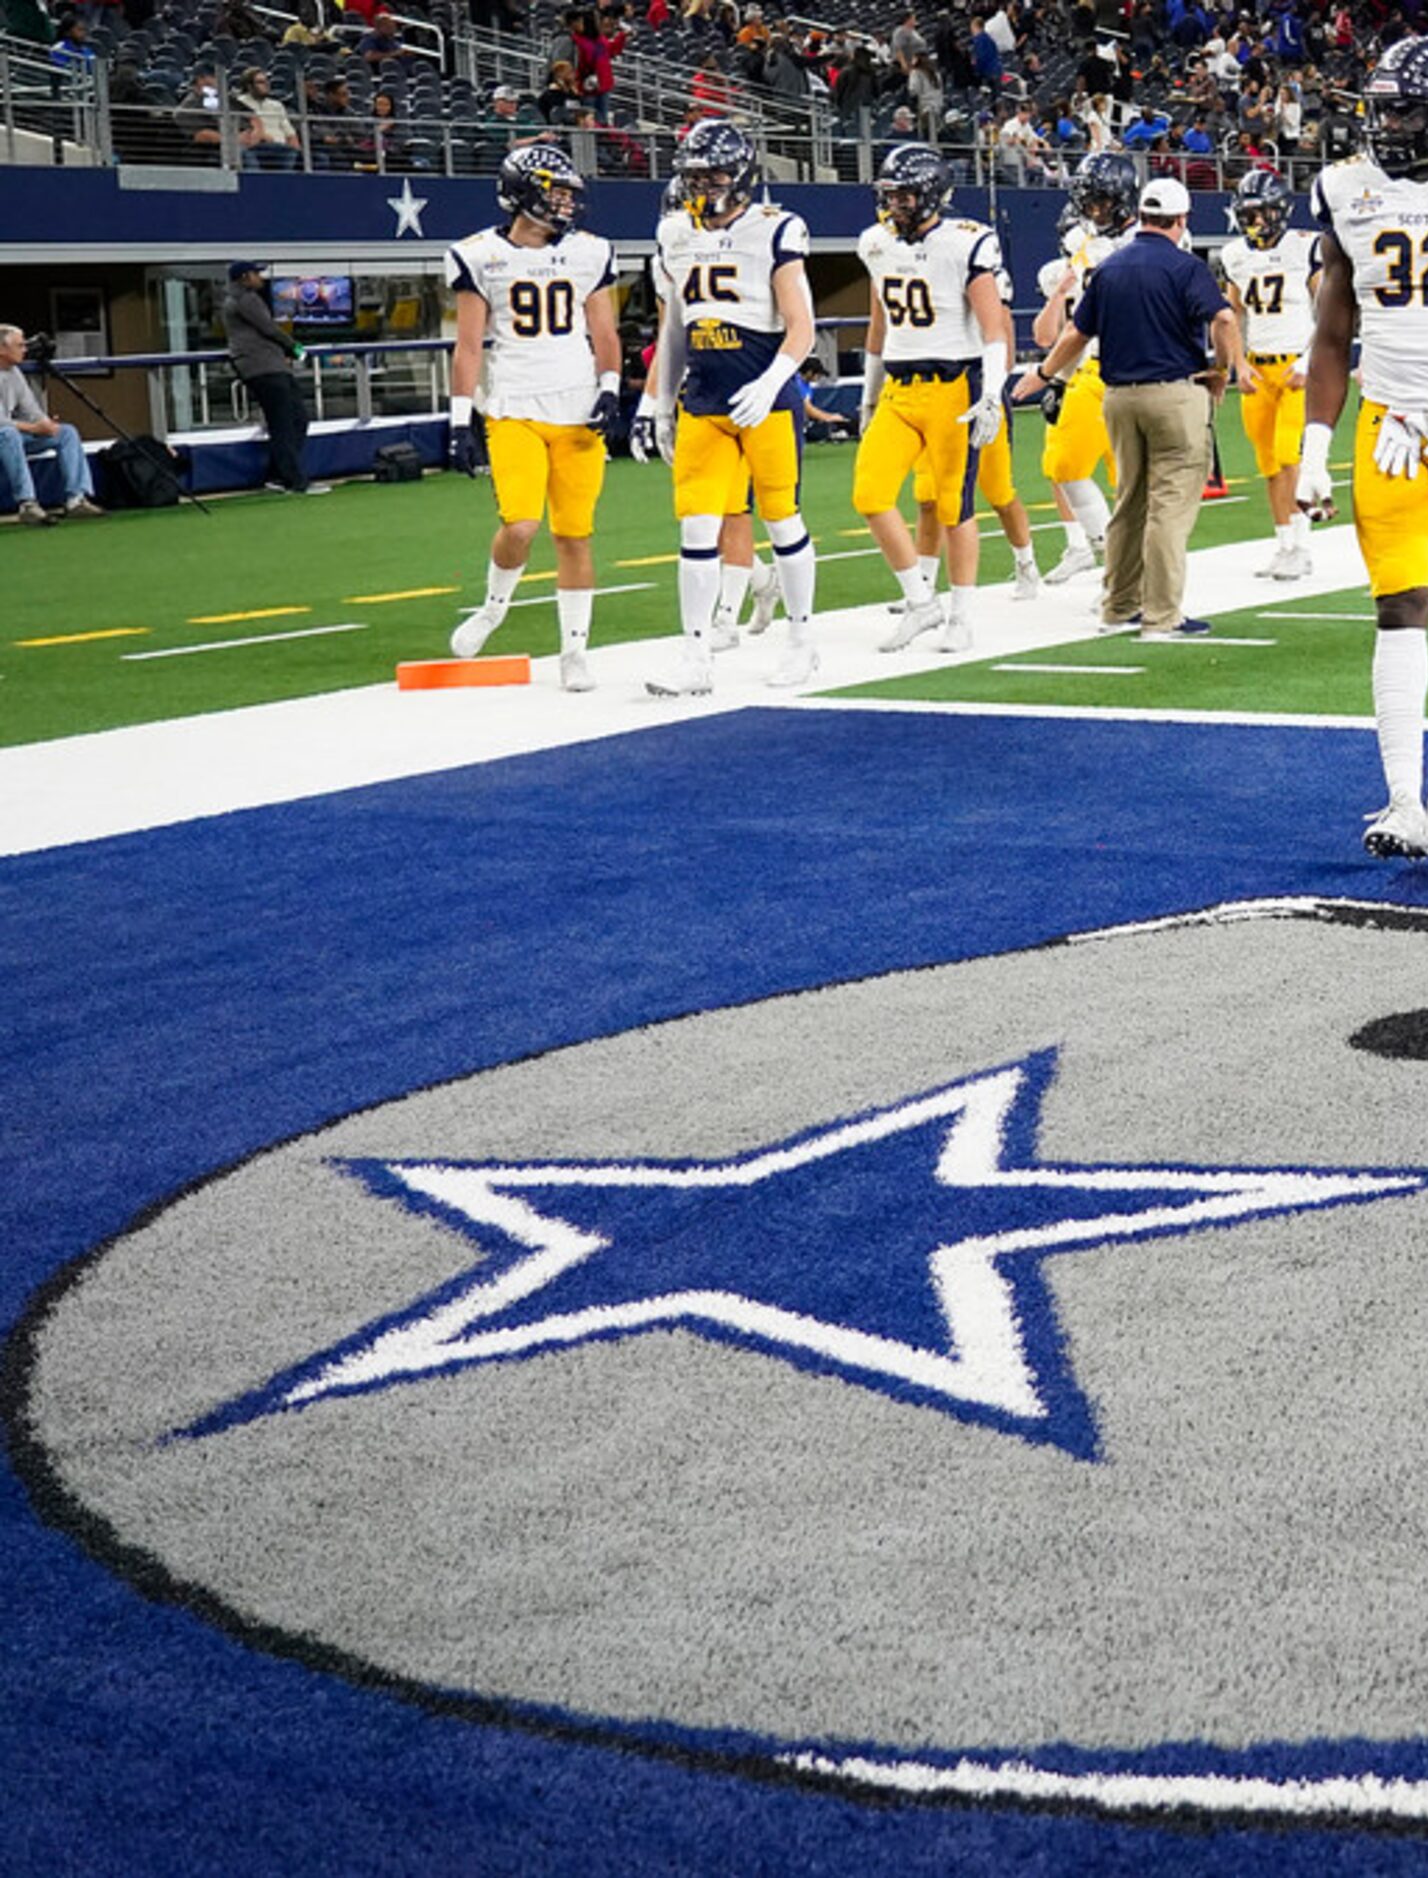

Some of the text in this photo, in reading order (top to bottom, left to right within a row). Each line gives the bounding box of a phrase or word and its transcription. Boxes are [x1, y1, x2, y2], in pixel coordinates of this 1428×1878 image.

[682, 265, 740, 304] 45
[883, 277, 936, 328] 50
[1244, 273, 1285, 315] 47
[509, 280, 574, 337] 90
